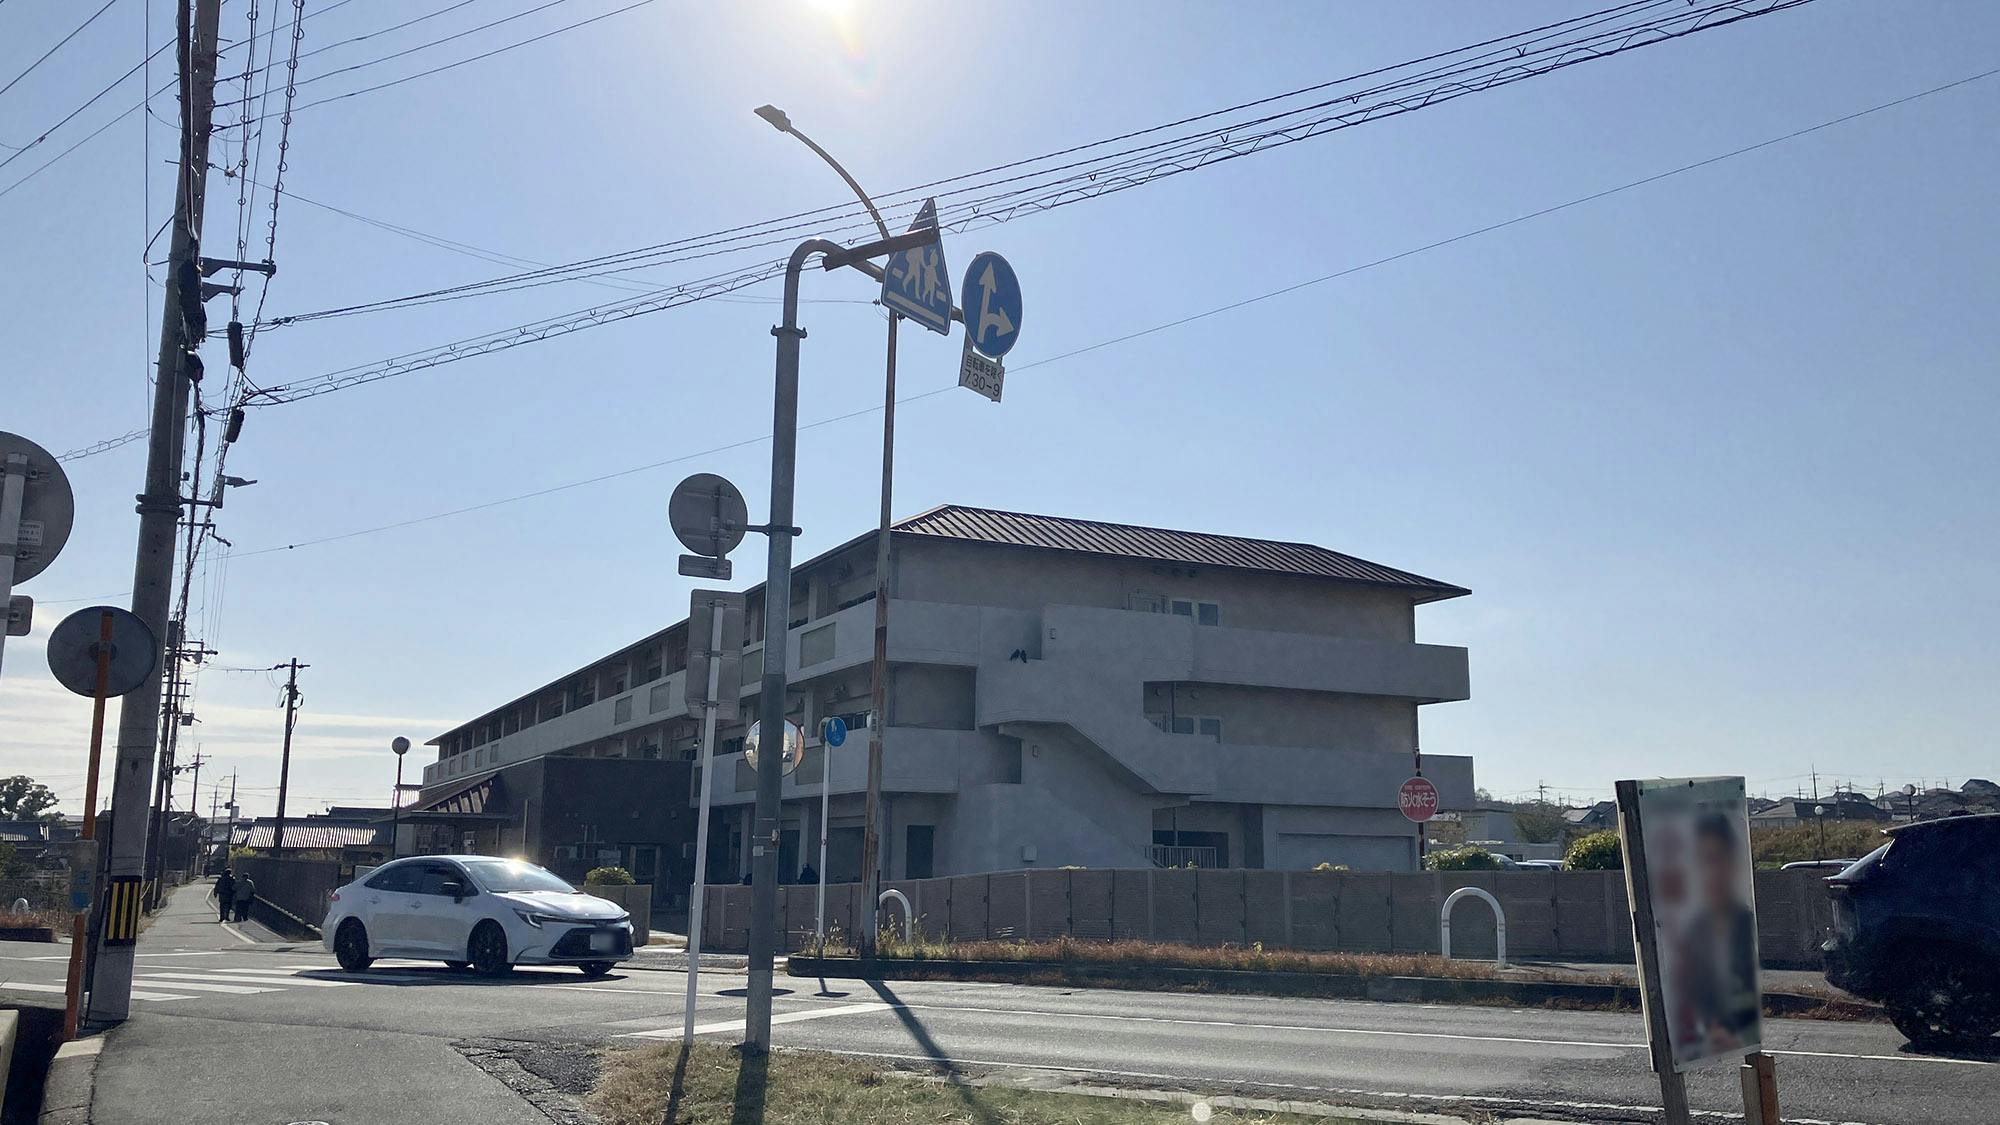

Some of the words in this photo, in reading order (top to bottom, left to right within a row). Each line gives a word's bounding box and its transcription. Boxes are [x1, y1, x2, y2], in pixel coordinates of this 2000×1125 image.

[1401, 791, 1436, 808] 防火水そう
